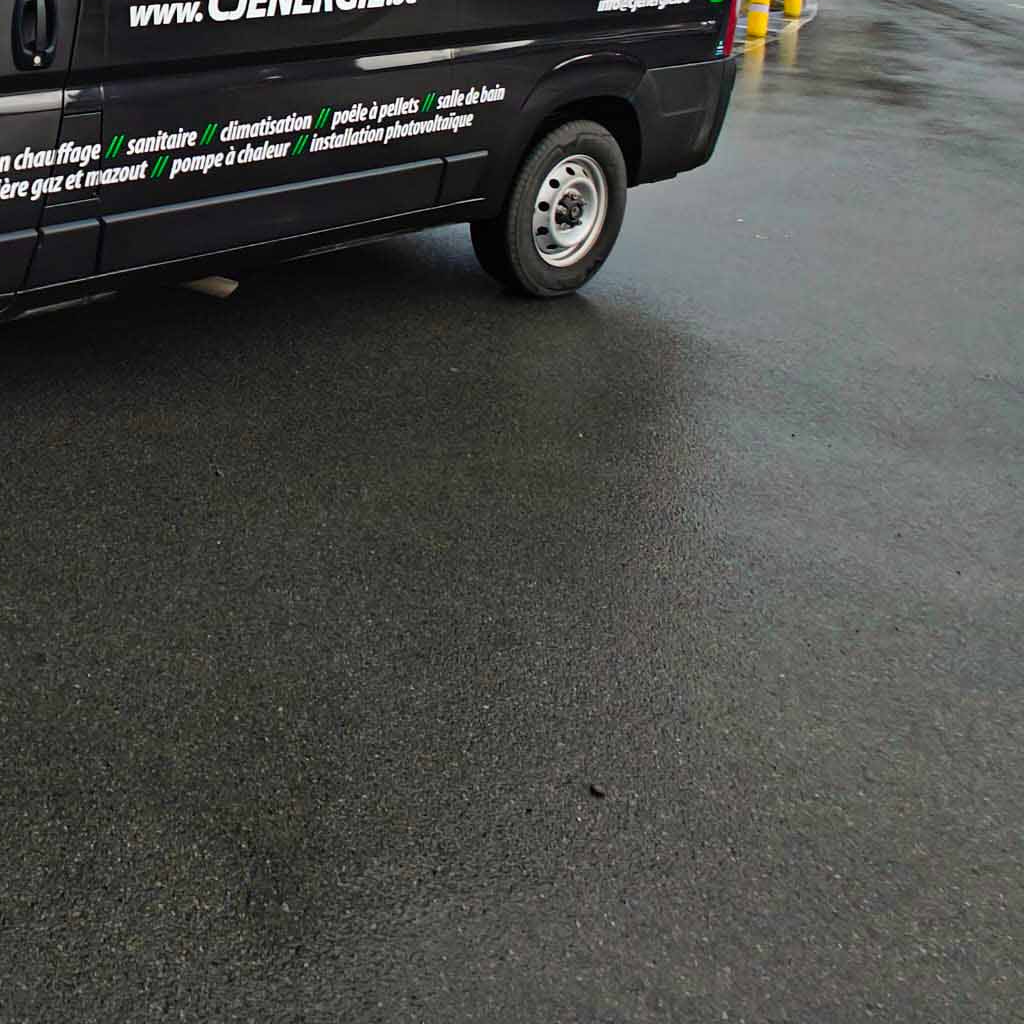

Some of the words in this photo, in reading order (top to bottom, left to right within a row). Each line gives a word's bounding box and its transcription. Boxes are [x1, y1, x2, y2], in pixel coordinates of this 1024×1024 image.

[14, 140, 101, 171] chauffage
[126, 127, 198, 156] sanitaire
[219, 112, 313, 142] climatisation
[330, 103, 372, 130] poêle
[368, 101, 380, 121] à
[377, 96, 420, 123] pellets
[436, 89, 464, 110] salle
[465, 86, 479, 105] de
[480, 84, 506, 103] bain
[30, 177, 63, 201] gaz
[65, 170, 82, 189] et
[84, 160, 149, 187] mazout
[169, 152, 228, 180] pompe
[224, 145, 236, 166] à
[236, 139, 292, 165] chaleur
[309, 127, 384, 153] installation
[384, 112, 475, 145] photovoltaïque
